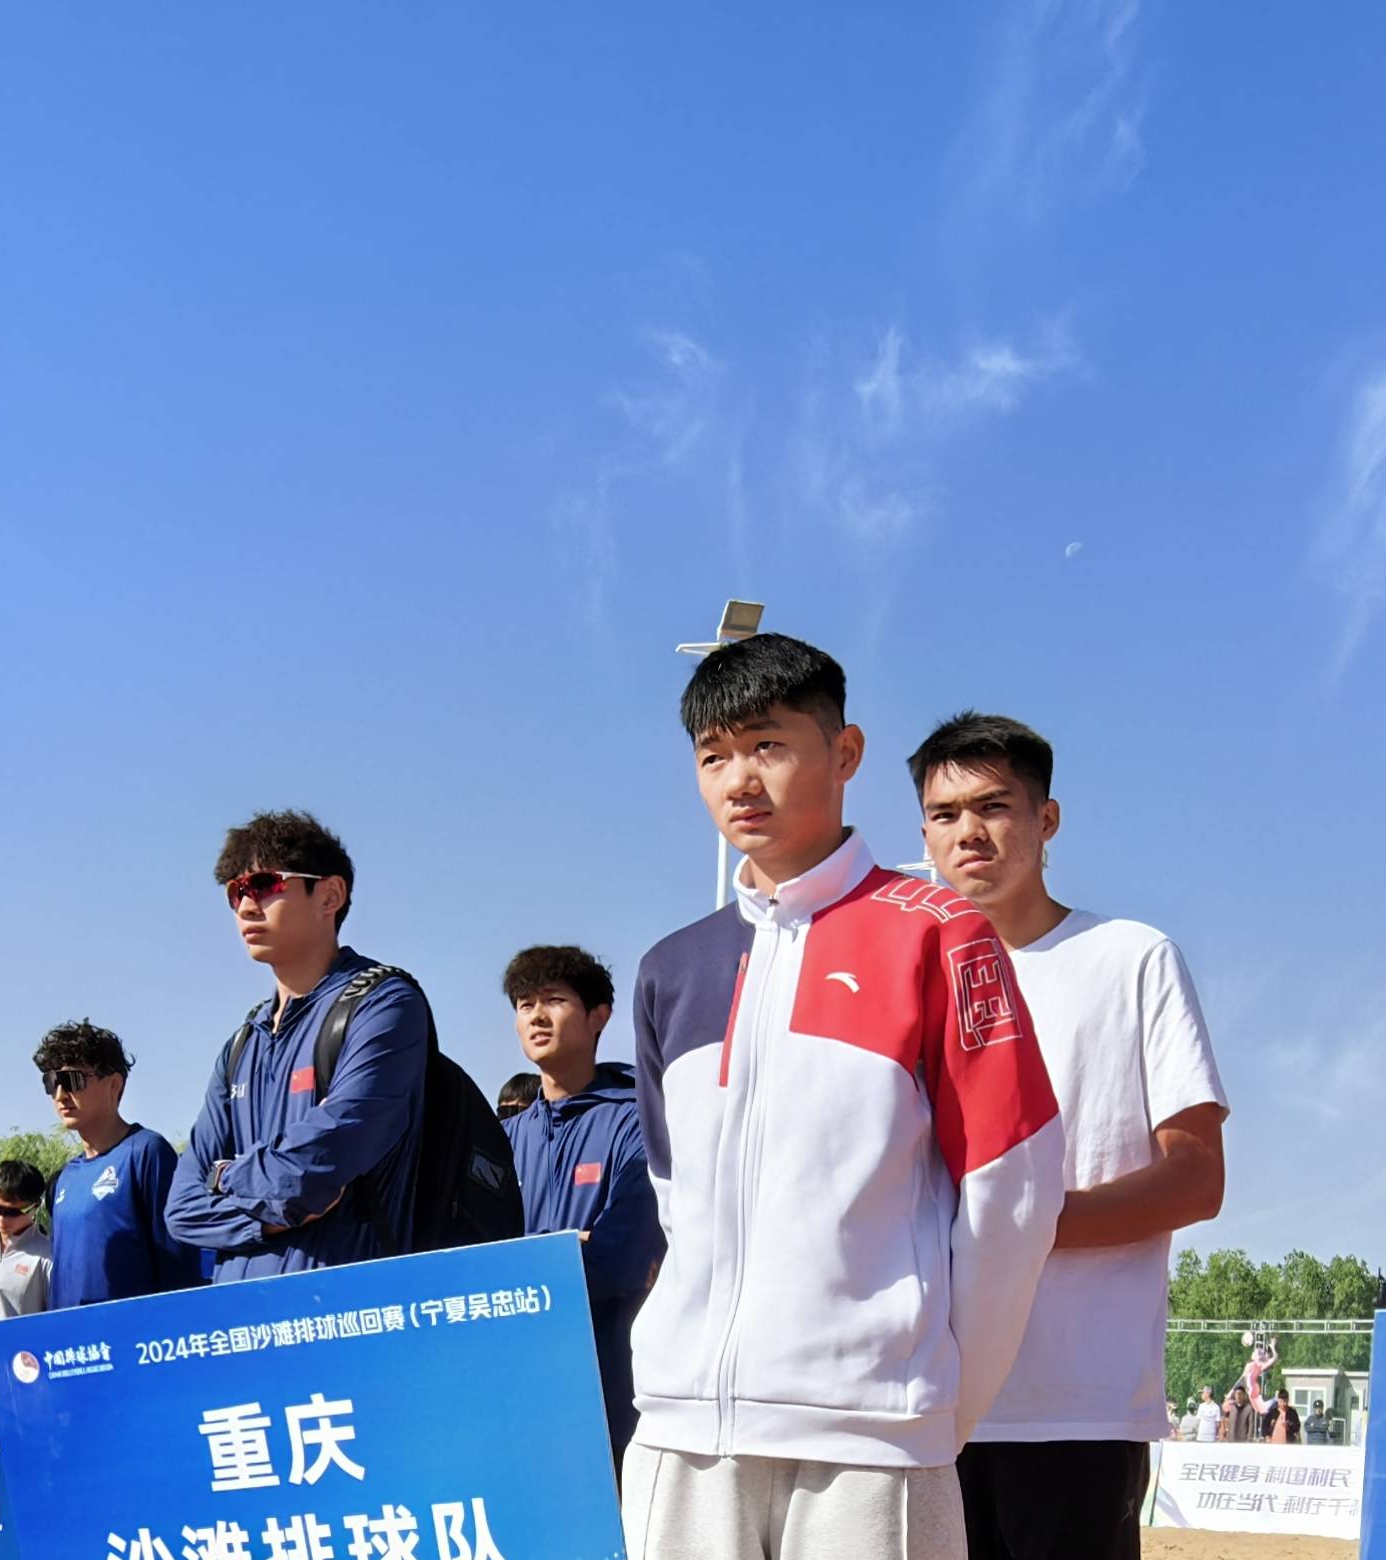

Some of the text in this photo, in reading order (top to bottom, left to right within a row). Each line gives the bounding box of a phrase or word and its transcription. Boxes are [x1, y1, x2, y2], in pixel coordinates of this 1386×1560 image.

[136, 1284, 551, 1364] 2024年全国沙滩排球巡回赛（宁夏吴忠站）
[198, 1393, 365, 1492] 重庆
[1179, 1462, 1261, 1484] 全民健身
